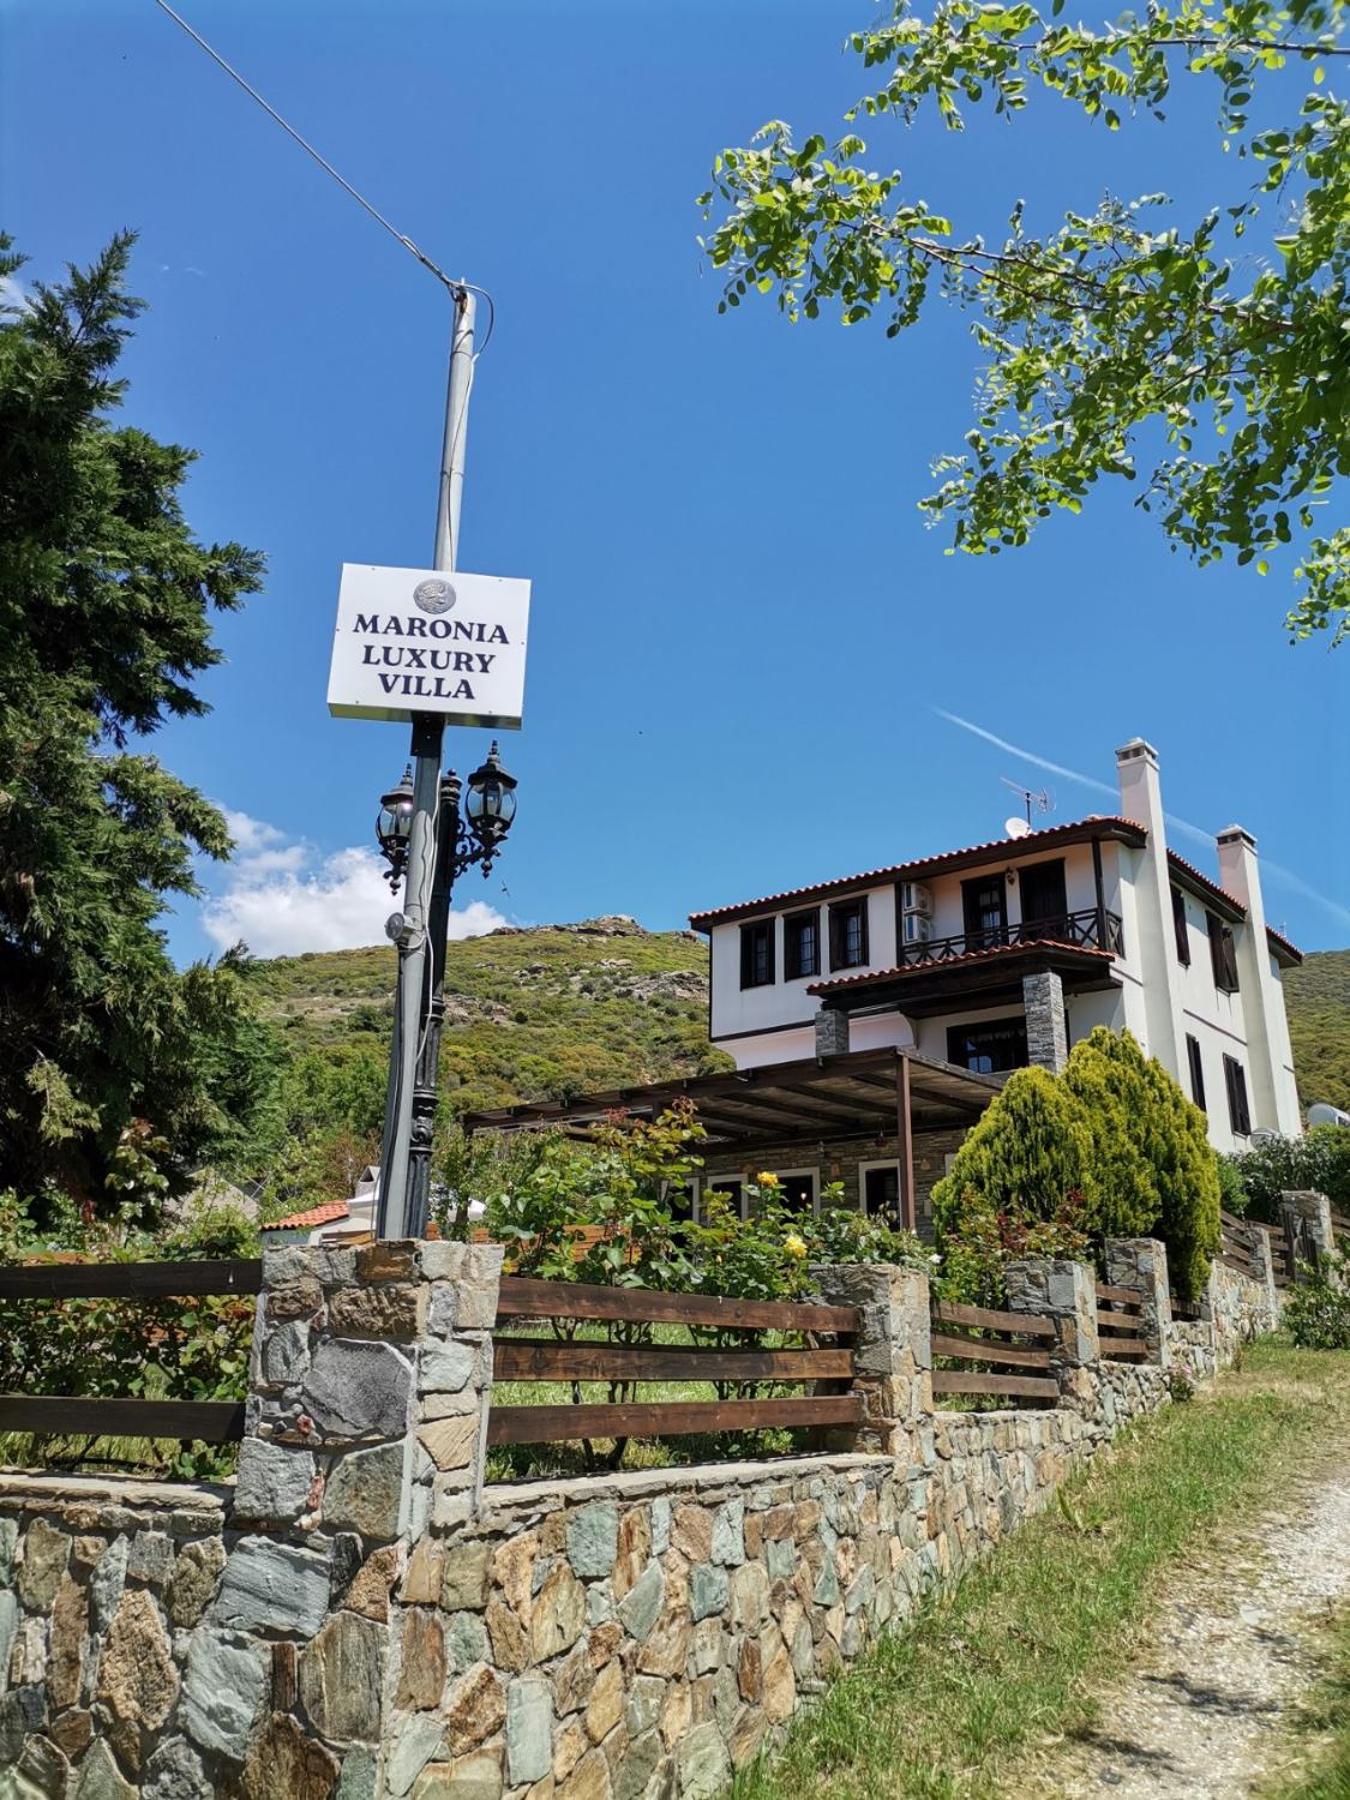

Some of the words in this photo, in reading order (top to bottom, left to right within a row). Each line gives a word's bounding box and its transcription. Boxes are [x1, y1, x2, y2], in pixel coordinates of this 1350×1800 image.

[353, 614, 509, 644] MARONIA
[363, 645, 495, 673] LUXURY
[378, 673, 474, 699] VILLA
